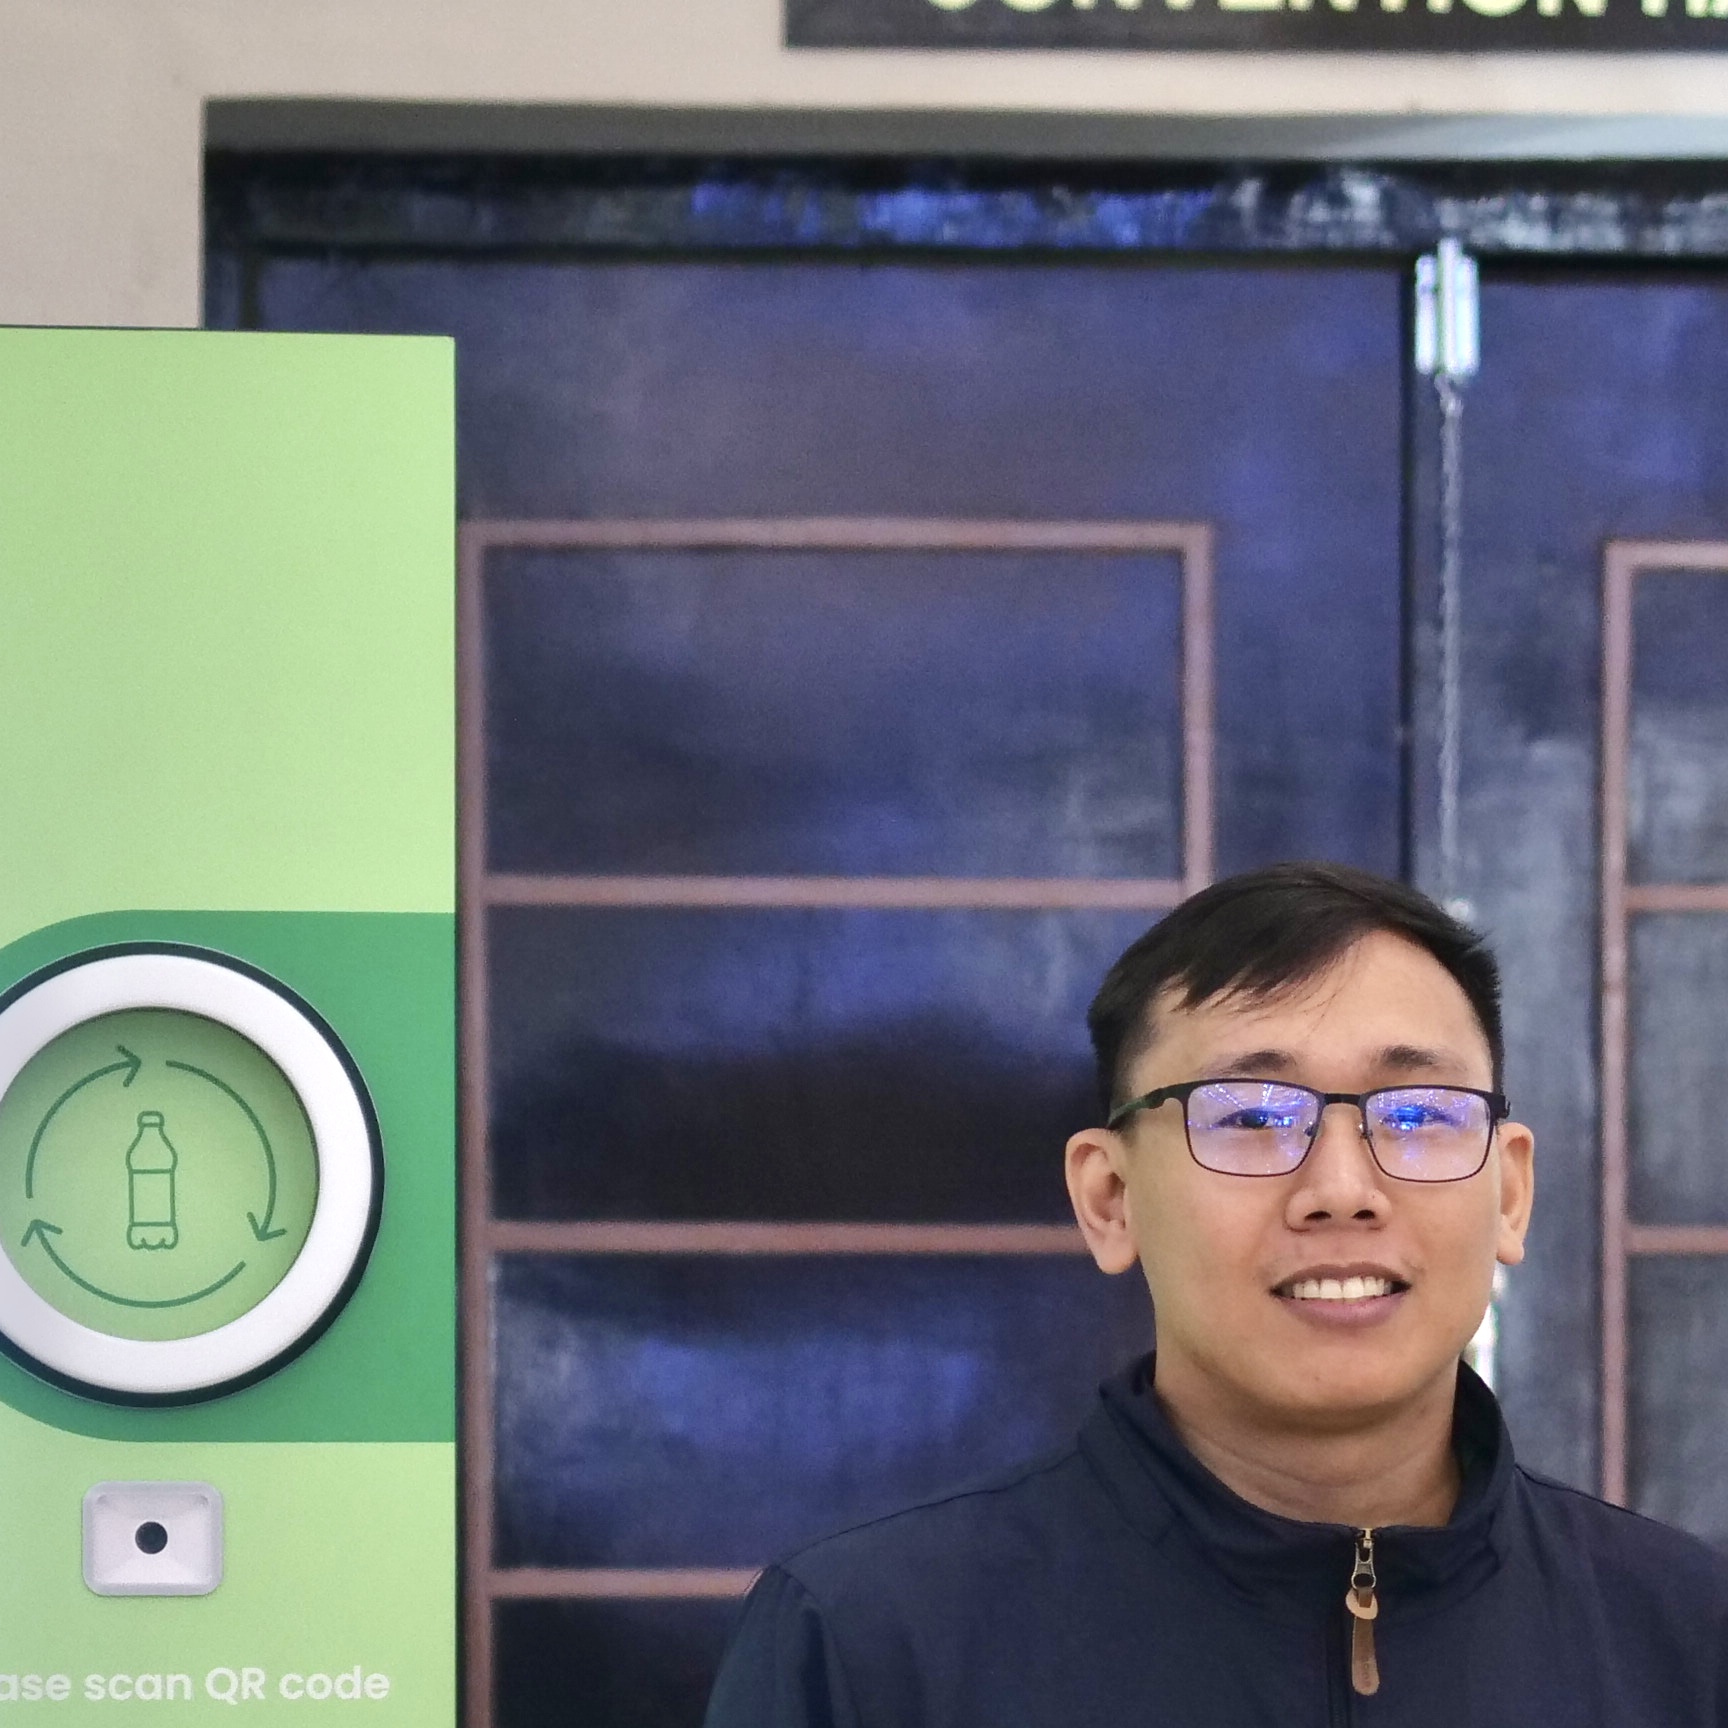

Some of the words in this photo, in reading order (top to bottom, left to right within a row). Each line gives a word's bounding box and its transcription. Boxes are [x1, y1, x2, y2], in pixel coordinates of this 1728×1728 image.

[84, 1672, 193, 1701] scan
[205, 1666, 267, 1706] QR
[278, 1665, 391, 1701] code
